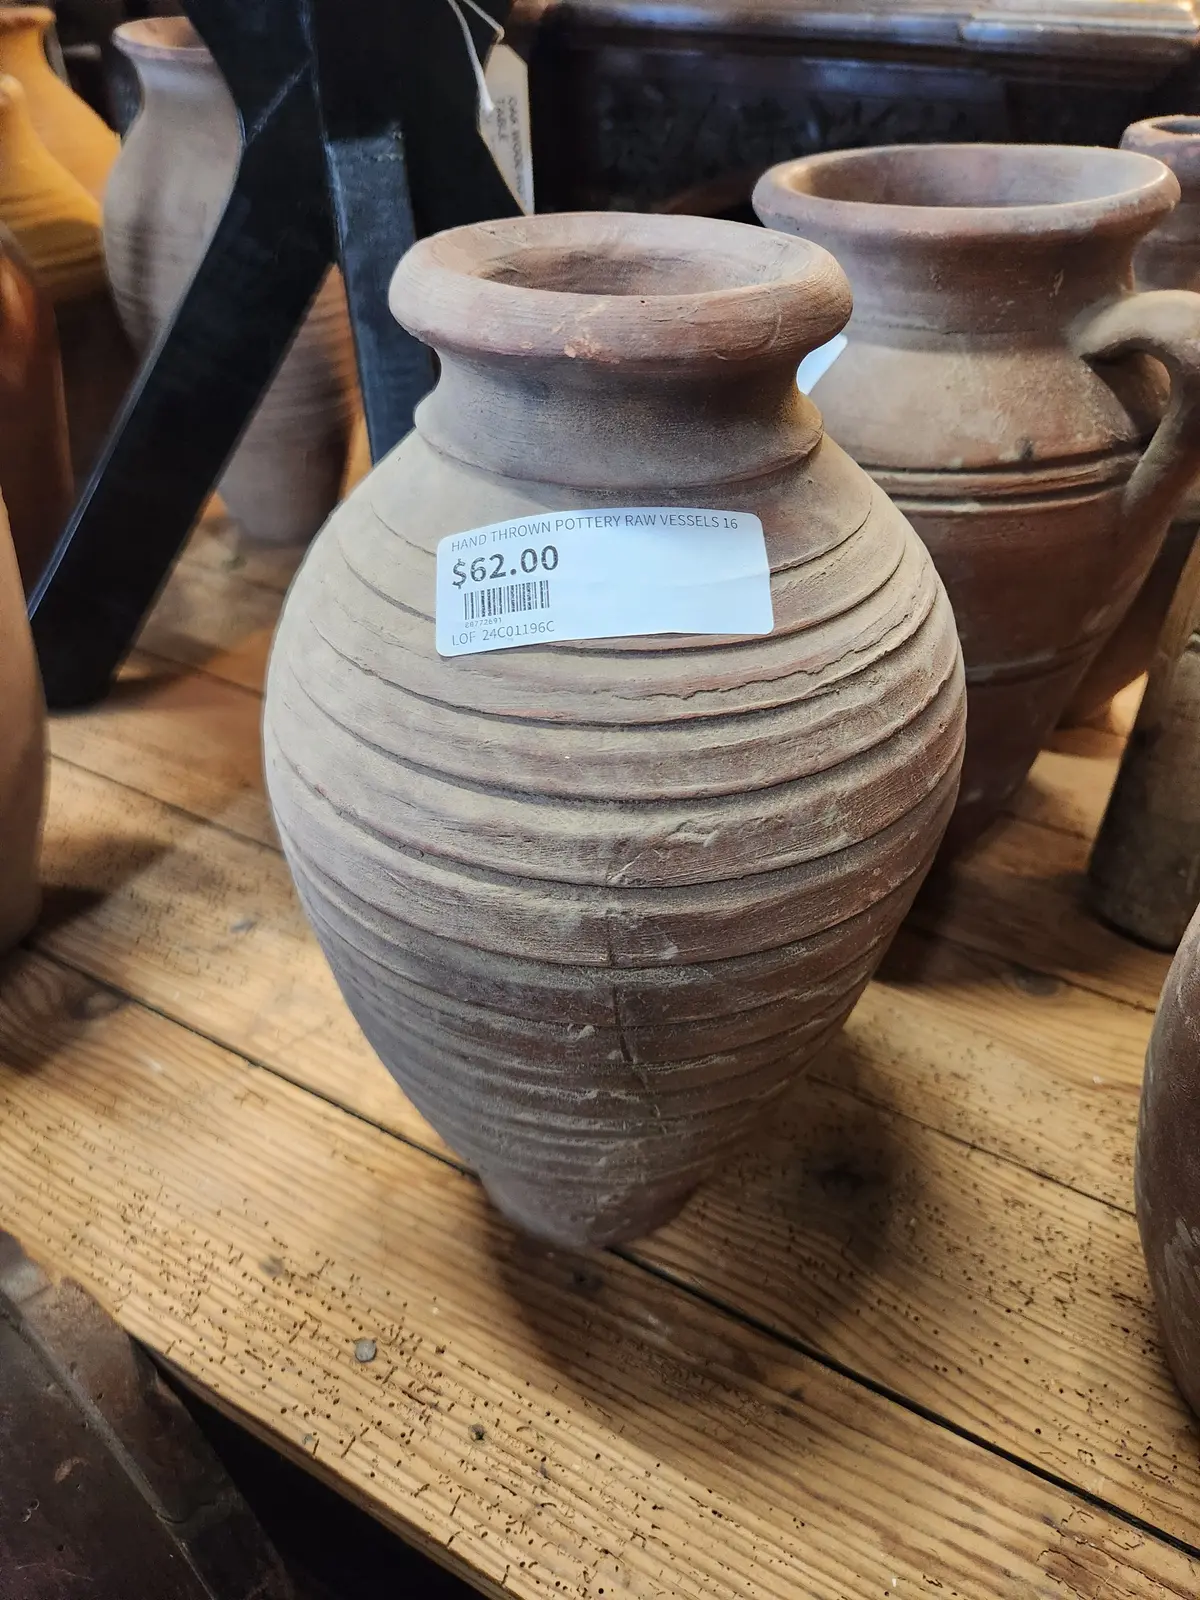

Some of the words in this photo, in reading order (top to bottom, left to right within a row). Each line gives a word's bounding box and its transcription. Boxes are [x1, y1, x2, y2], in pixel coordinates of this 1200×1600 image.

[451, 534, 487, 552] HAND
[492, 521, 551, 542] THROWN
[555, 515, 621, 531] POTTERY
[625, 514, 656, 526] RAW
[661, 514, 720, 528] VESSELS
[723, 517, 738, 529] 16
[452, 545, 559, 589] $62.00
[452, 630, 476, 646] LOF
[482, 620, 555, 641] 24C01196C
